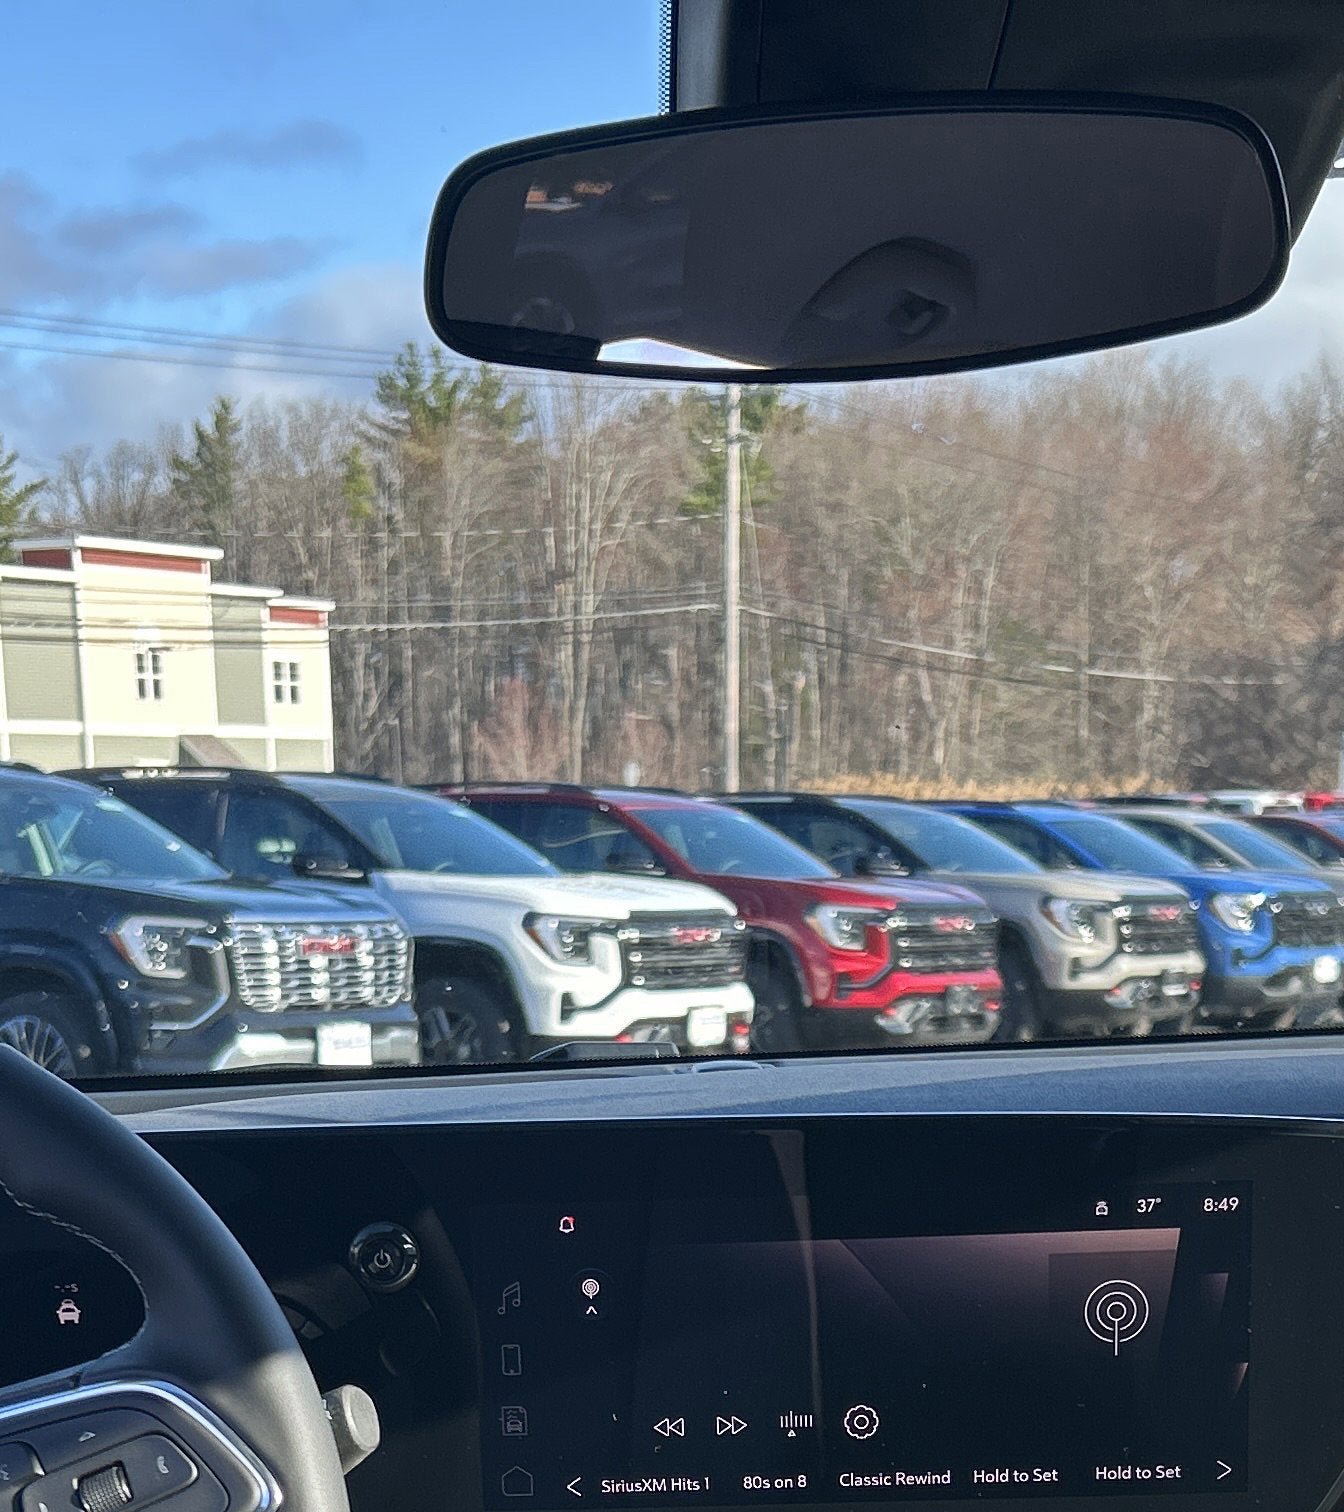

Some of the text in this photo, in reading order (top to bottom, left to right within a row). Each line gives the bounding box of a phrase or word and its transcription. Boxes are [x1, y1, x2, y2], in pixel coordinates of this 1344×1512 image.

[1203, 1196, 1239, 1212] 8:49
[839, 1470, 951, 1487] Classic Rewind
[973, 1468, 1059, 1484] Hold to Set
[1095, 1465, 1182, 1480] Hold to Set
[601, 1477, 710, 1494] SiriusXM Hits 1
[743, 1475, 807, 1489] 80s on 8
